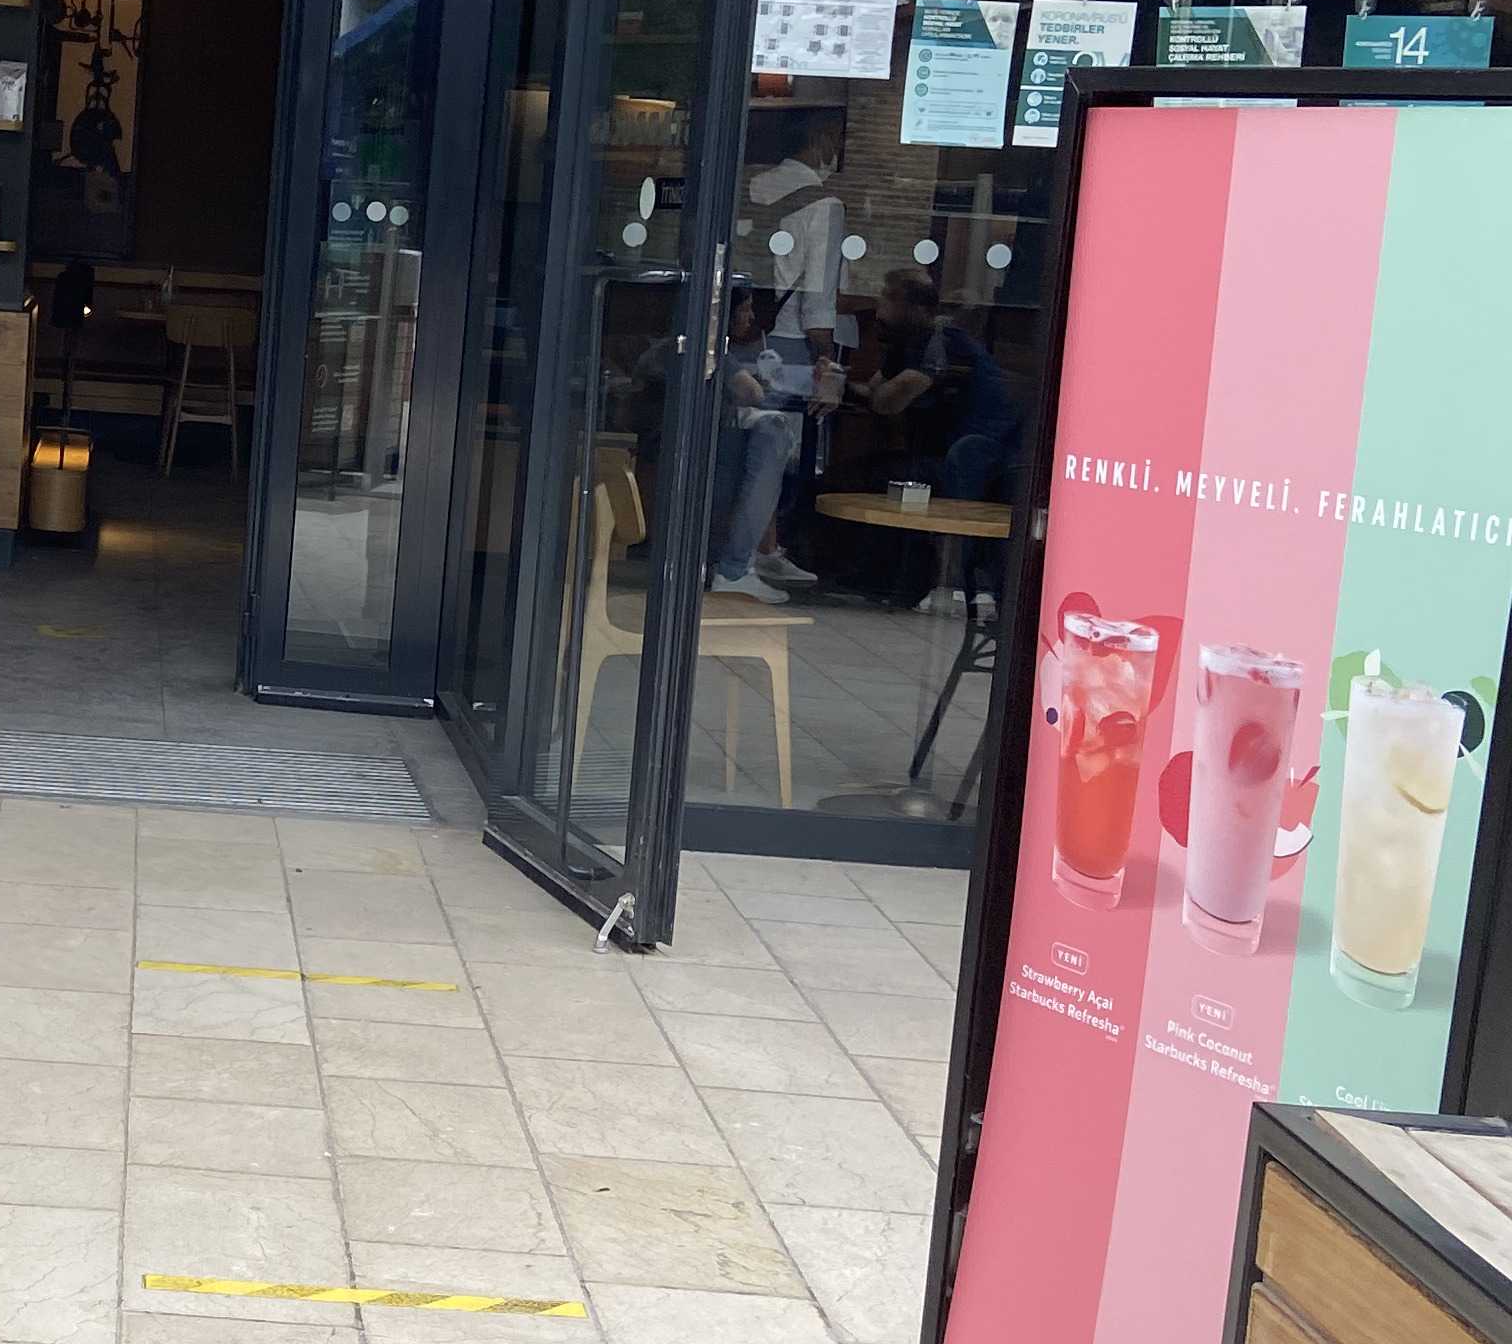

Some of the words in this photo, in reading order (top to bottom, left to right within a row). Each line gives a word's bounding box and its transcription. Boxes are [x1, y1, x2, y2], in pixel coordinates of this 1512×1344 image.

[1390, 26, 1430, 65] 14
[1065, 454, 1160, 493] RENKLİ.
[1175, 470, 1300, 515] MEYVELİ.
[1009, 981, 1065, 1014] Starbucks
[1021, 964, 1086, 1002] Strawberry
[1144, 1035, 1207, 1072] Starbucks
[1167, 1019, 1195, 1043] Pink
[1198, 1033, 1254, 1066] Coconut
